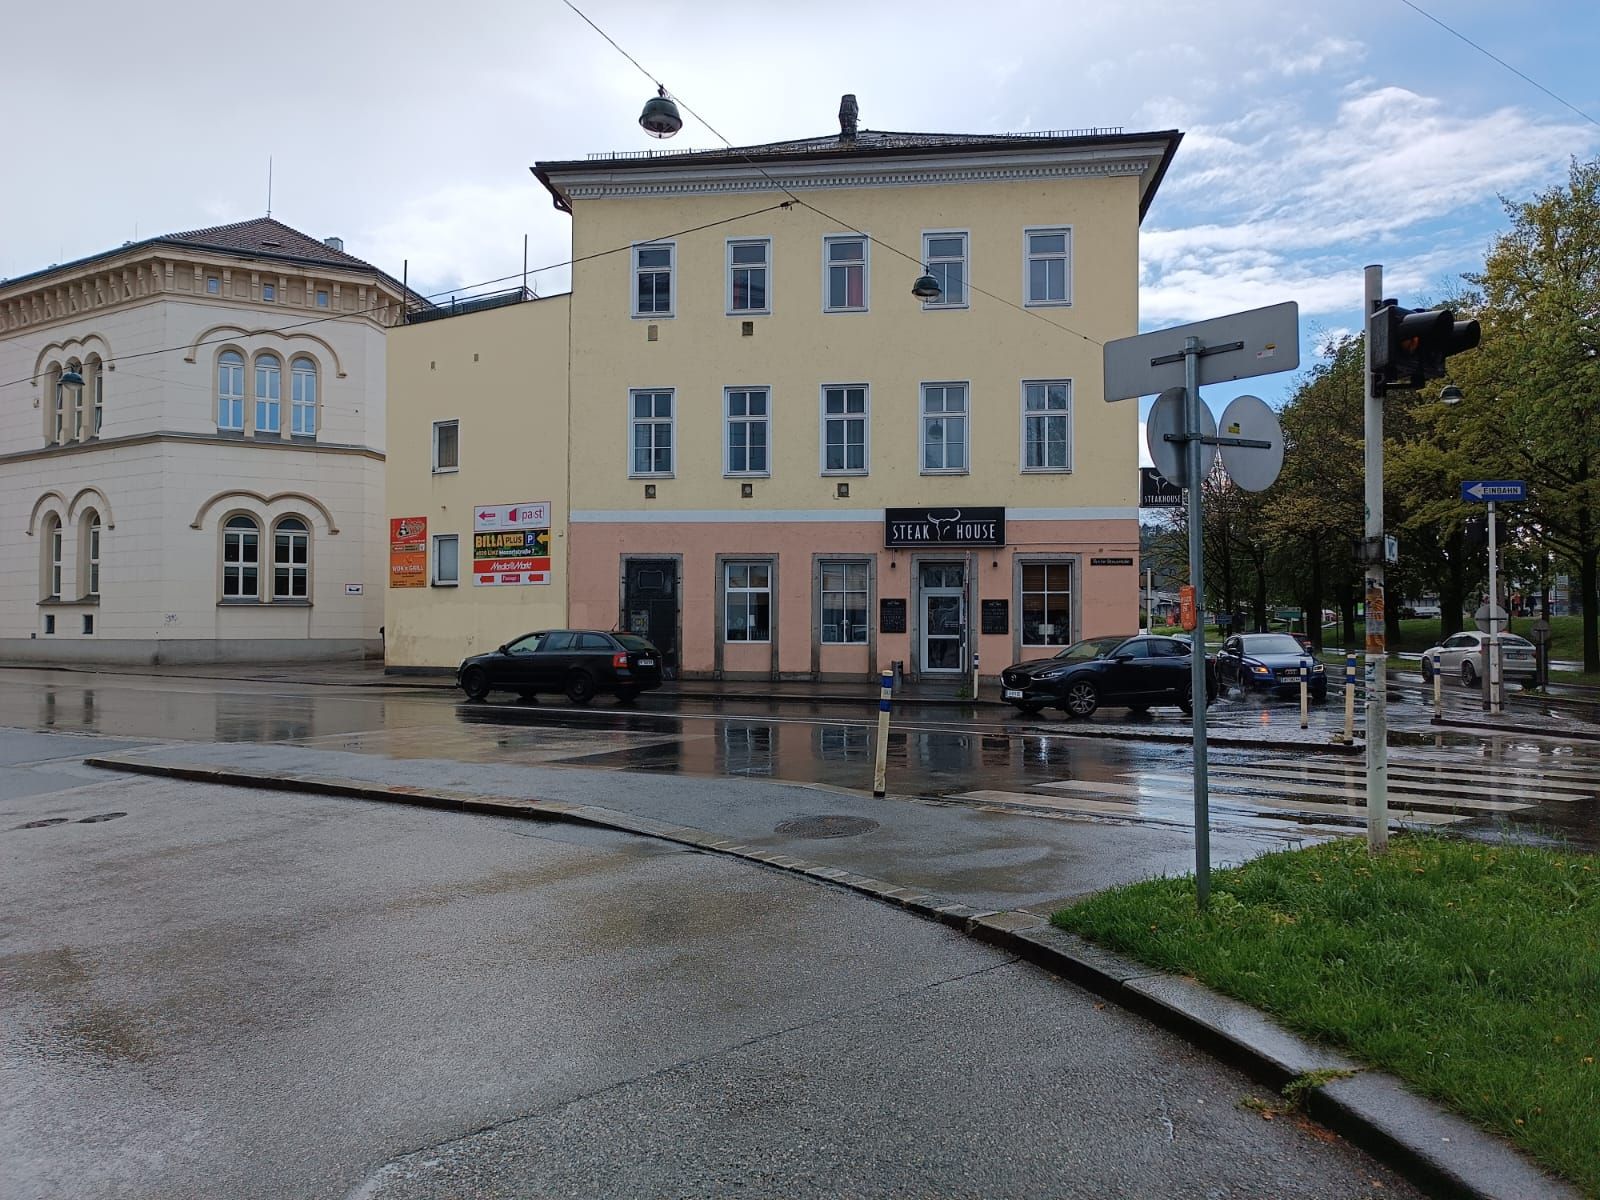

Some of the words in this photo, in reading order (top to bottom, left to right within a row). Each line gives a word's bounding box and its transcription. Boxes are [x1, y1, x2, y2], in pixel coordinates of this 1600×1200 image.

[1144, 495, 1181, 503] STEAKHOUSE
[893, 524, 930, 540] STEAK
[956, 523, 996, 539] HOUSE
[475, 534, 503, 549] BILLA
[505, 536, 523, 545] PLUS
